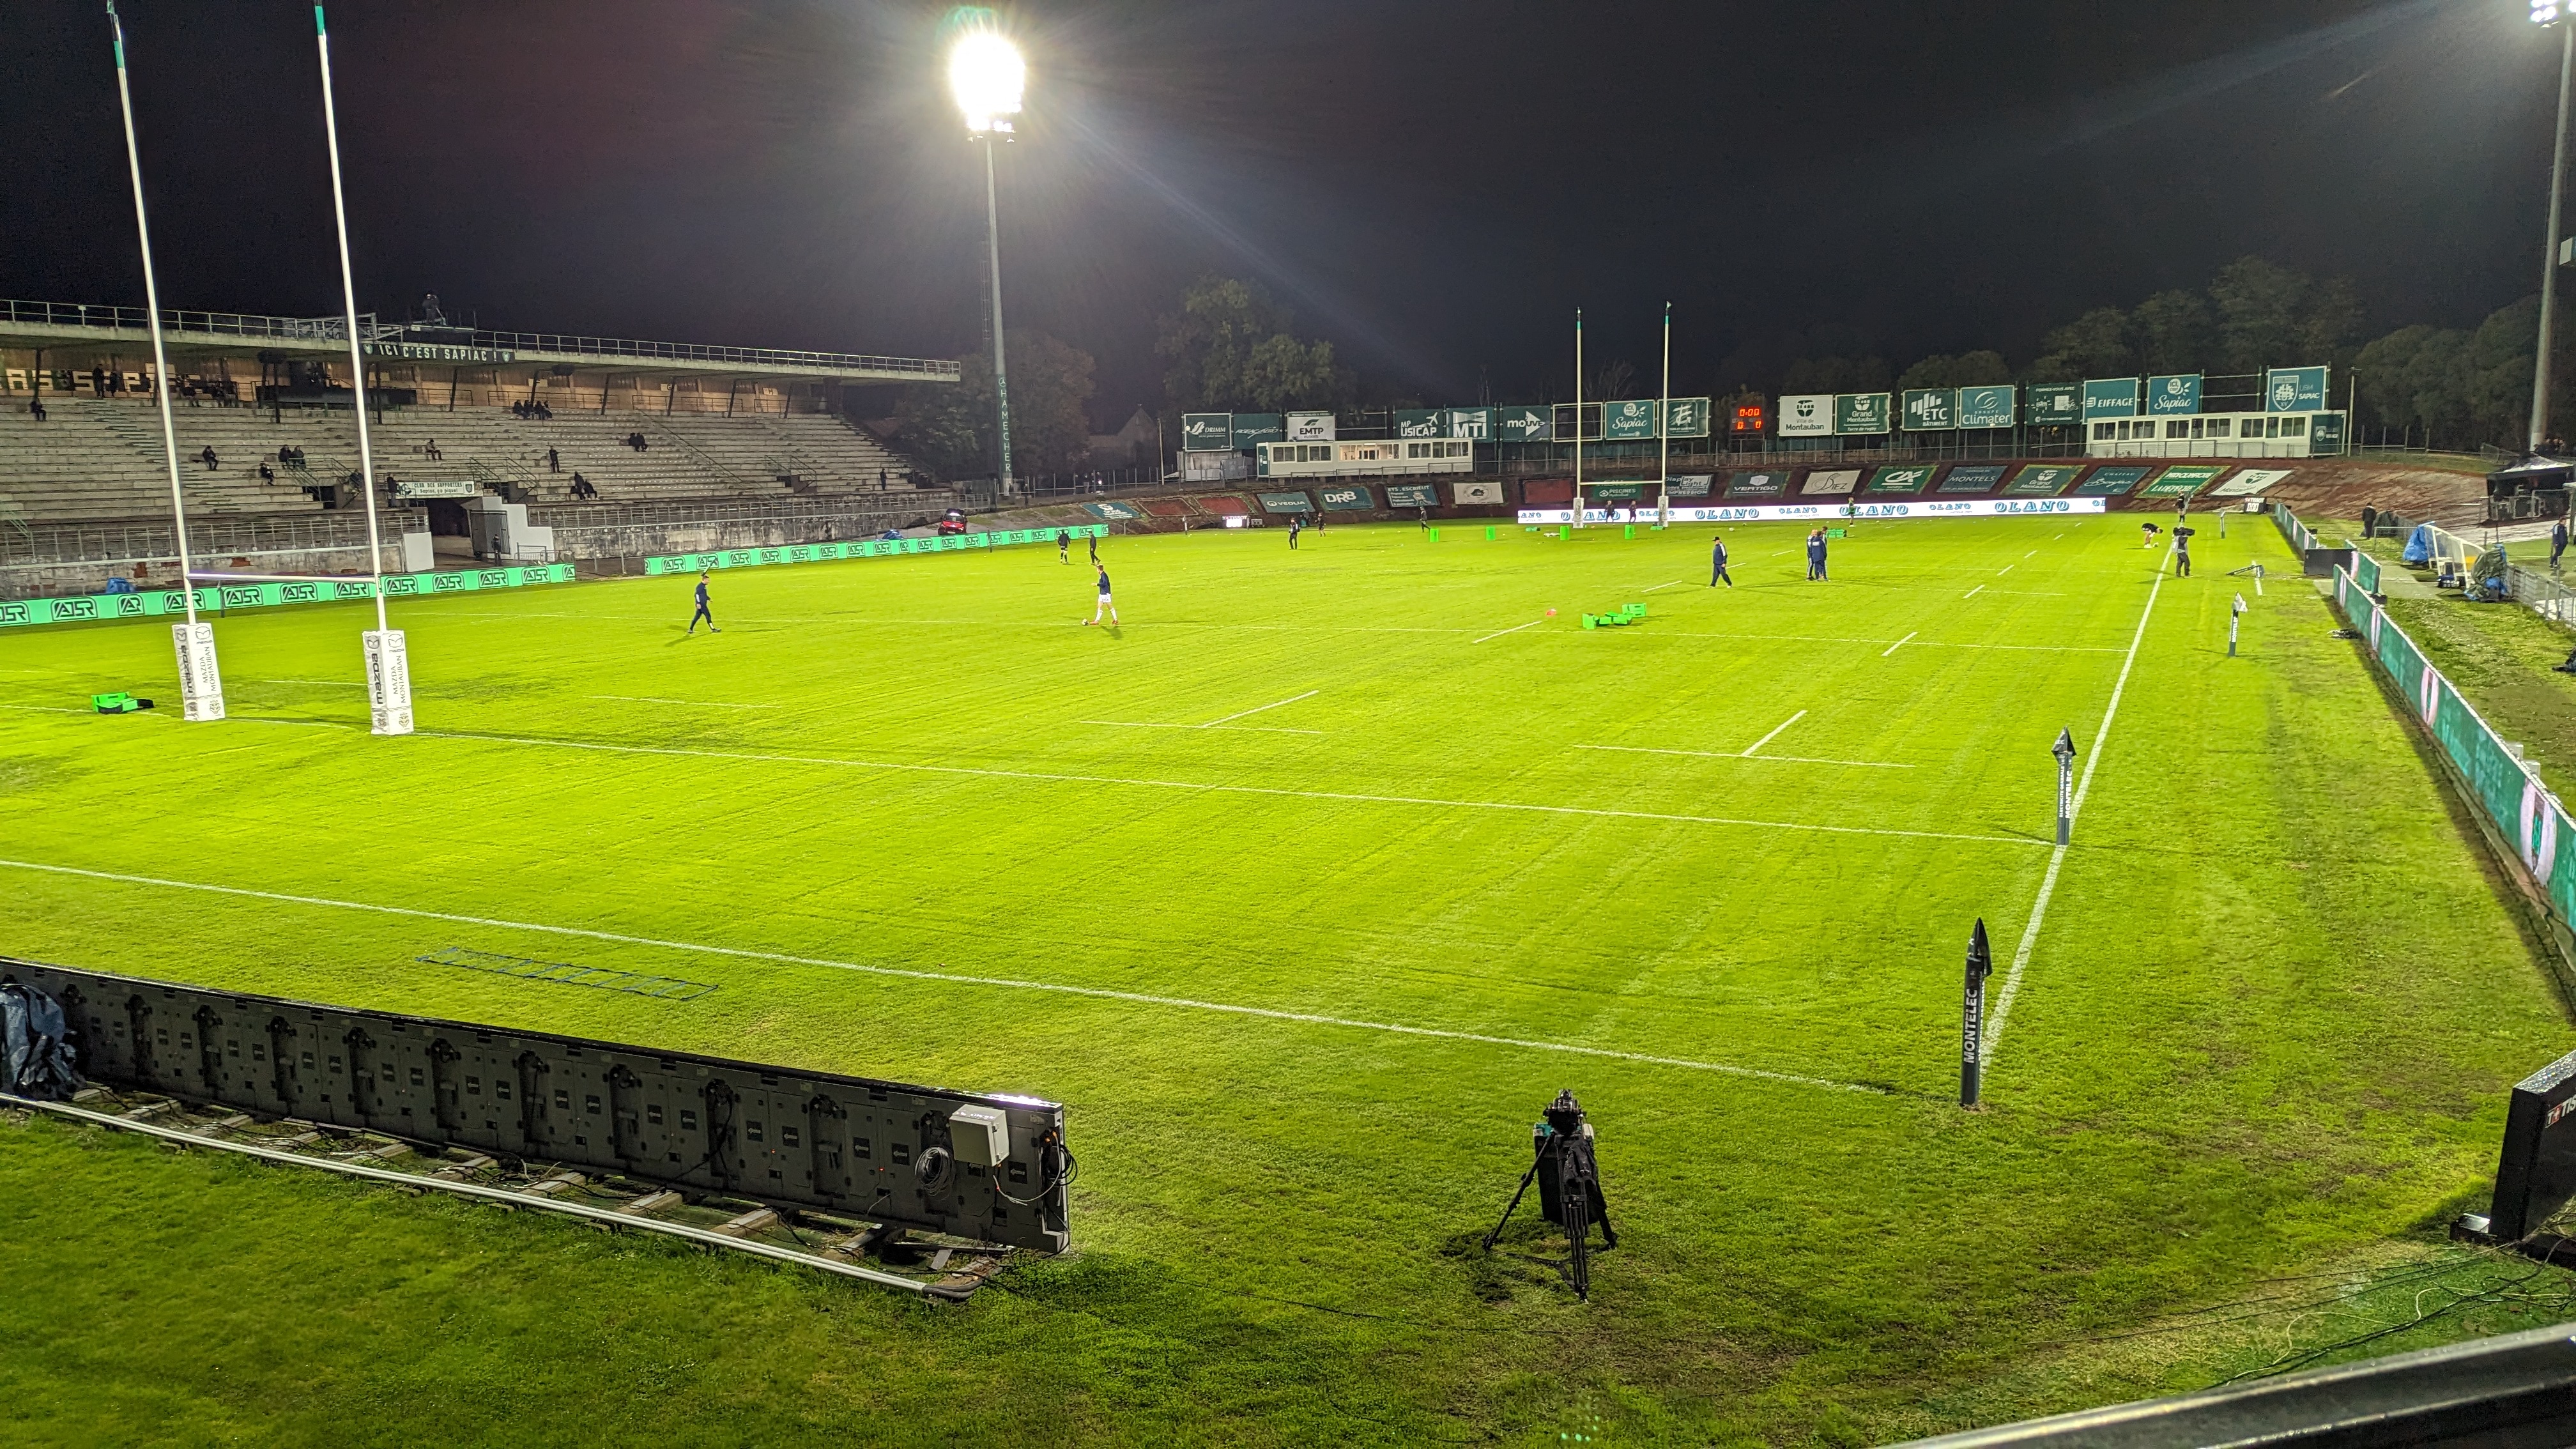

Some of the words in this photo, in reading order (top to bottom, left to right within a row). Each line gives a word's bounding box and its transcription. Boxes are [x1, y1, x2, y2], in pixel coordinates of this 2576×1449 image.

[379, 344, 399, 355] ICI
[403, 346, 437, 358] C'EST
[444, 348, 487, 361] SAPIAC
[2097, 397, 2134, 408] EIFFAGE
[2154, 394, 2191, 411] Sapiac
[1922, 408, 1948, 420] ETC
[1962, 414, 2011, 425] Climater
[1453, 423, 1487, 438] MTI
[1612, 417, 1648, 431] Sapiac
[1300, 427, 1324, 436] EMTP
[1400, 427, 1437, 436] USICAP
[1324, 491, 1356, 503] DRB
[1839, 505, 1908, 517] OLANO
[1995, 501, 2069, 512] OLANO
[1695, 509, 1759, 519] OLANO
[181, 645, 193, 693] mazda
[199, 656, 208, 683] MAZDA
[204, 647, 217, 691] MONTAUBAN
[371, 653, 383, 704] mazda
[396, 656, 406, 703] MONTAUBAN
[1963, 988, 1978, 1064] MONTELEC
